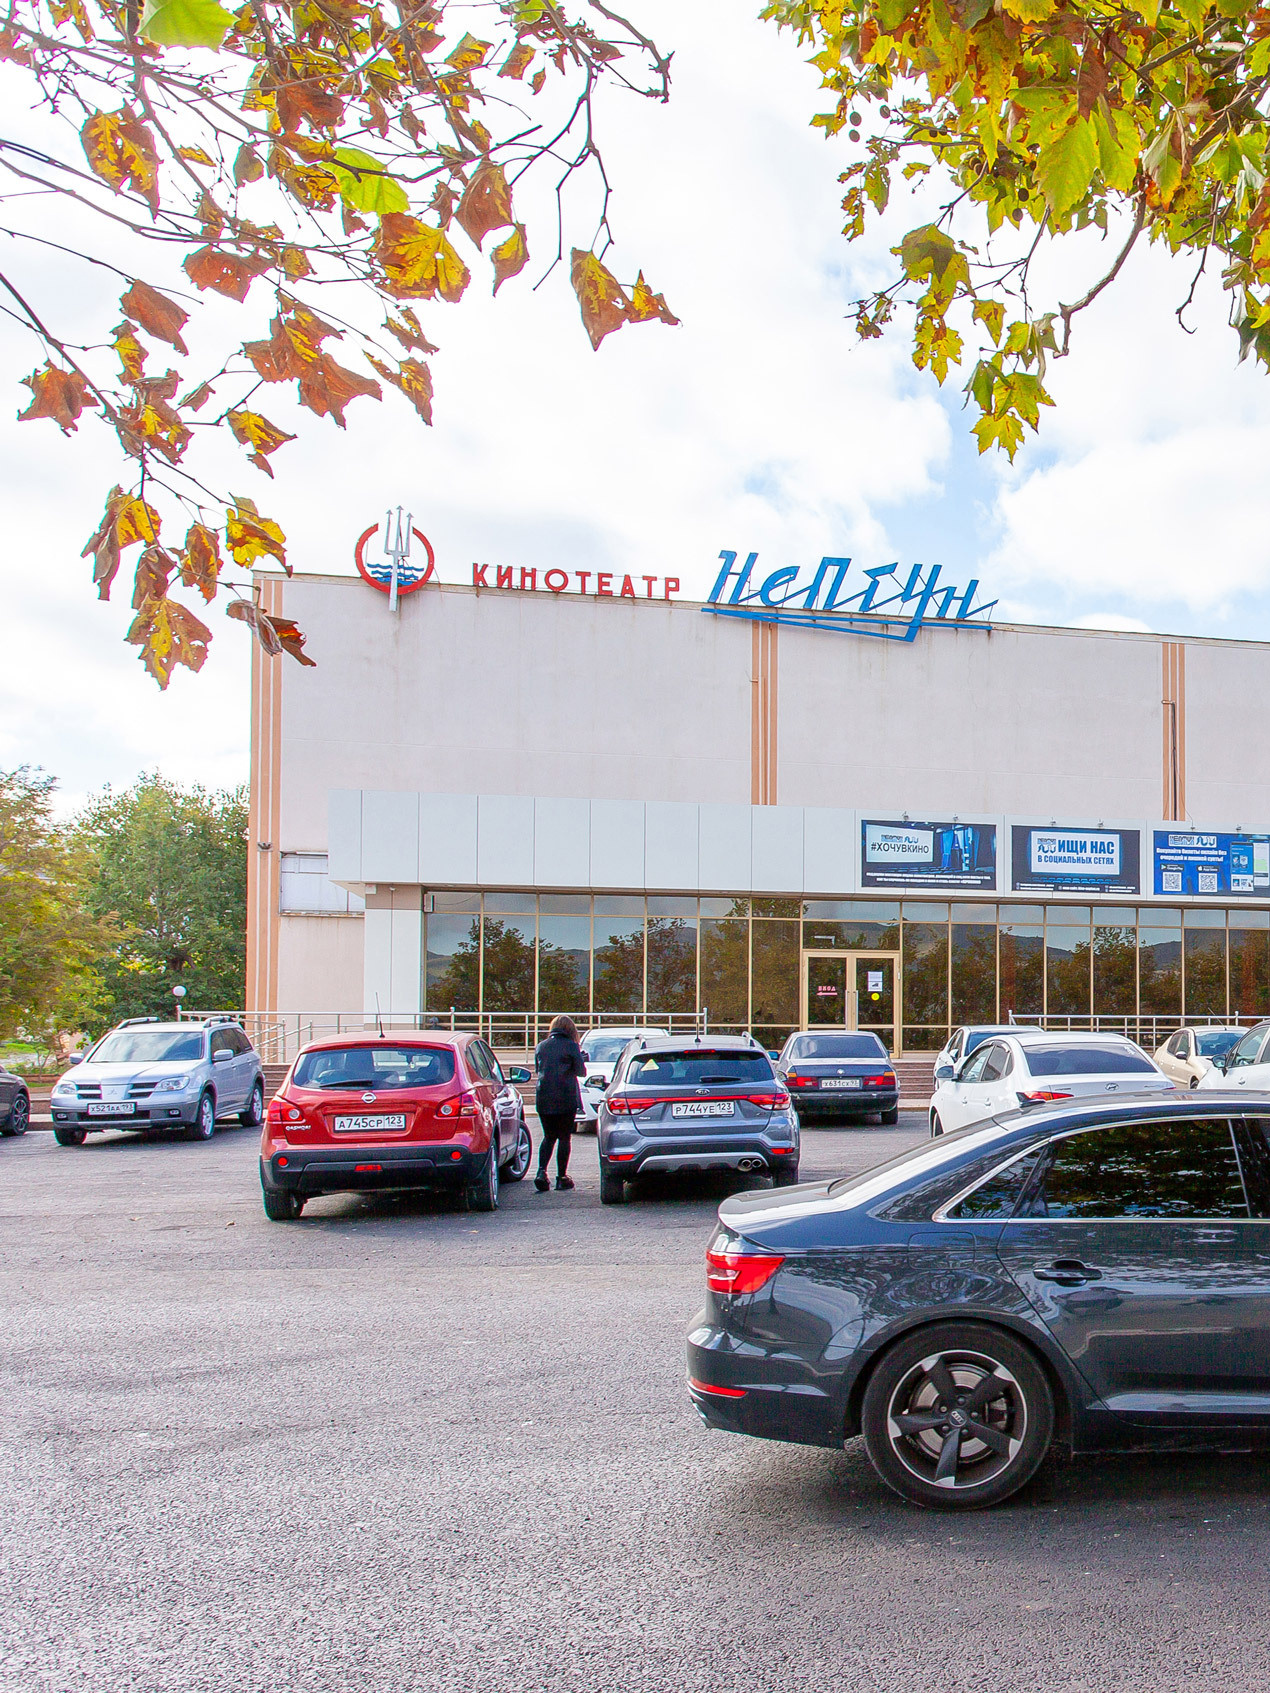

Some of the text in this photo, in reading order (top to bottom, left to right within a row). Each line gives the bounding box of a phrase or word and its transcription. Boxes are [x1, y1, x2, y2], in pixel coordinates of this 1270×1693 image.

[472, 562, 680, 600] КИНОТЕАТР
[871, 842, 930, 854] #ХОЧУВКИНО
[1058, 839, 1087, 855] ИЩИ
[1090, 841, 1115, 854] НАС
[1037, 855, 1114, 865] В СОЦИАЛЬНЫХ СЕТЯХ
[675, 1103, 732, 1114] Р744УЕ 123
[338, 1116, 402, 1129] А745СР 123
